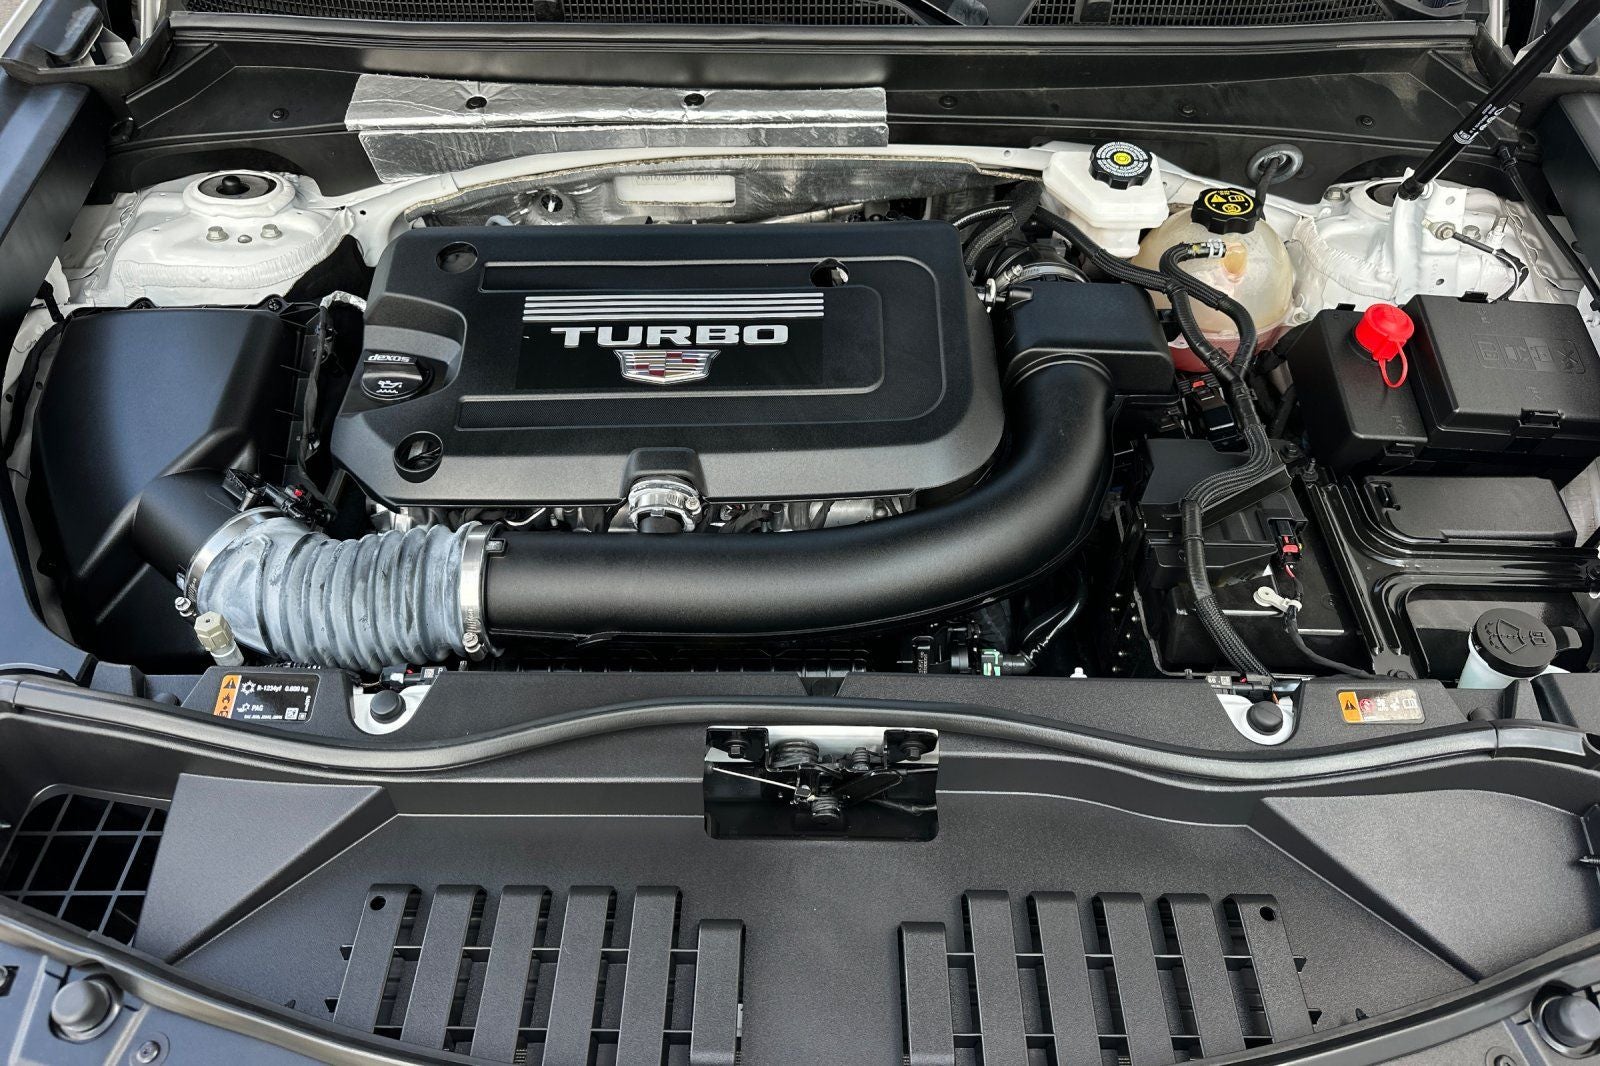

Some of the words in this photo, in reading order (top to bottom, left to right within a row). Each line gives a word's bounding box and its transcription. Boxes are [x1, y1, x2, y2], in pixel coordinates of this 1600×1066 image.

[550, 324, 789, 348] TURBO
[367, 353, 411, 363] dexos
[256, 684, 283, 693] R-1234yf
[300, 685, 309, 693] kg
[251, 704, 264, 712] PAG
